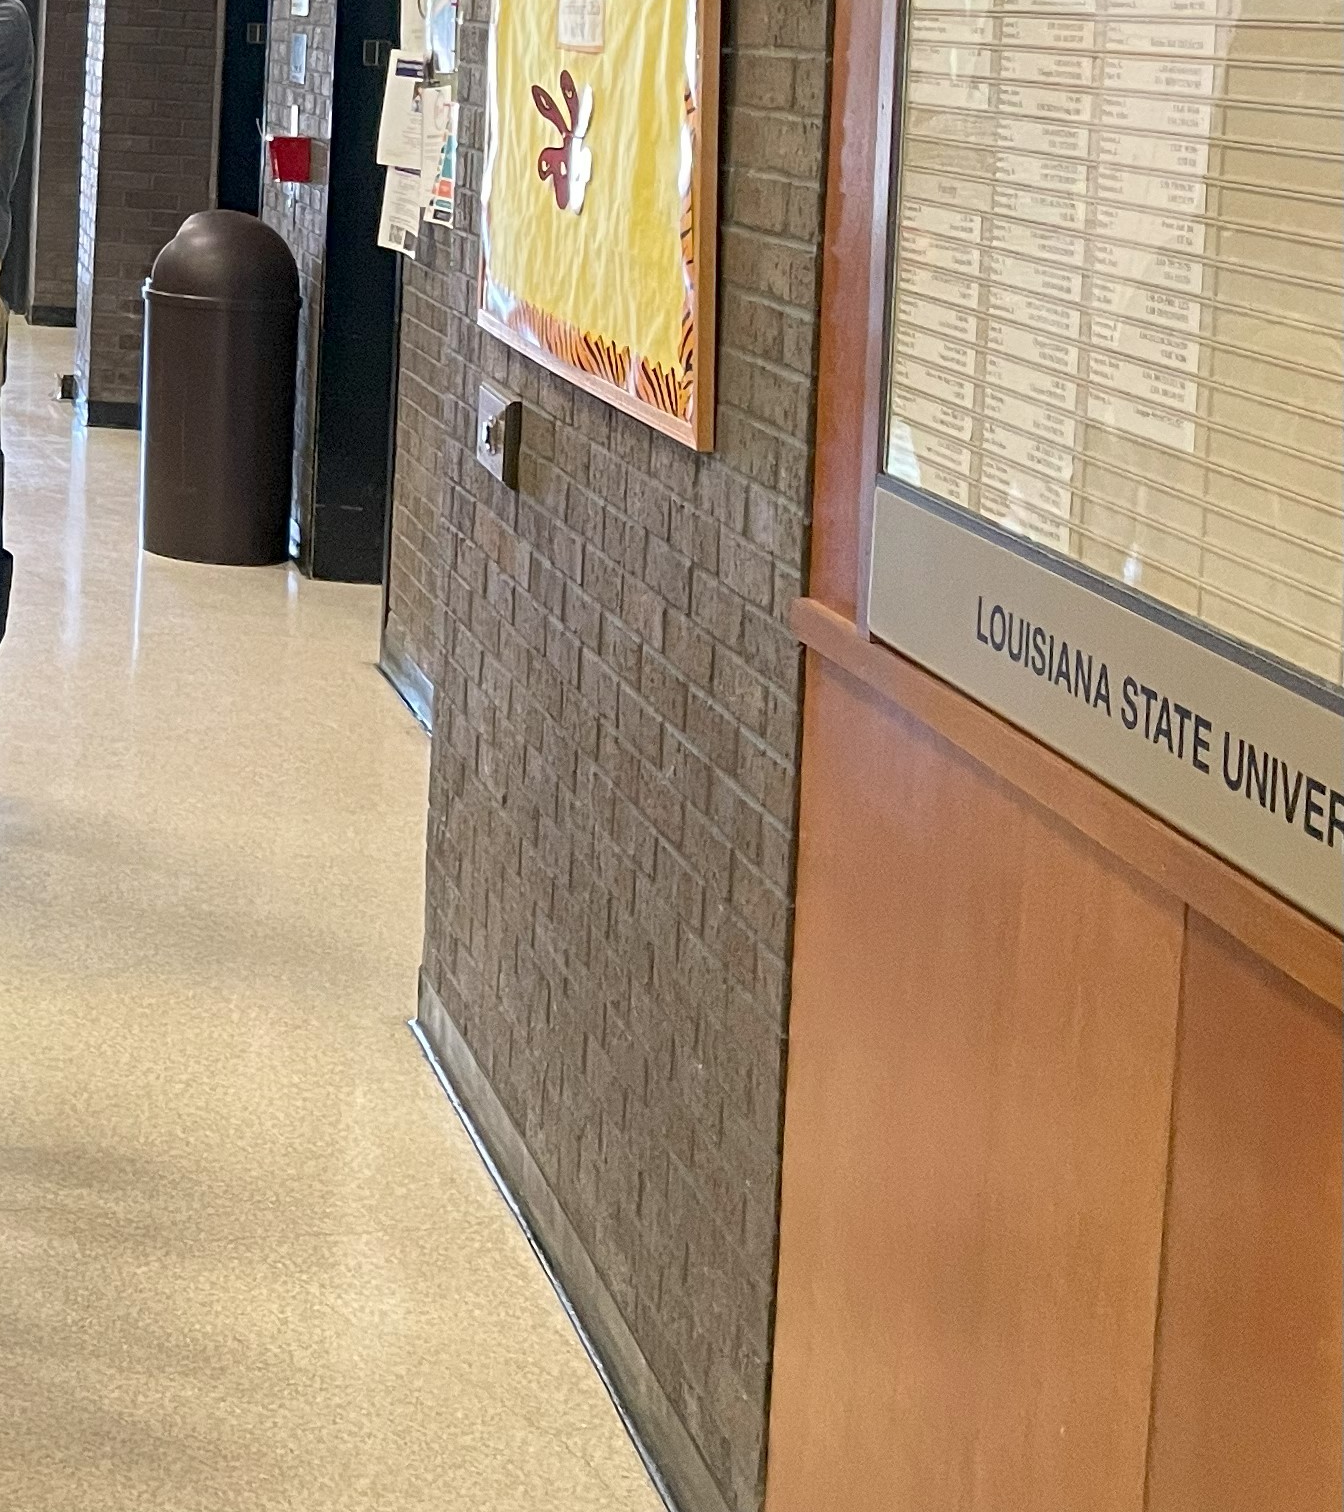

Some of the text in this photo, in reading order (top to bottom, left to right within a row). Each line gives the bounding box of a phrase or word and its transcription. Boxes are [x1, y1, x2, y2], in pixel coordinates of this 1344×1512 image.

[976, 595, 1344, 848] LOUISIANA STATE UNIVER
